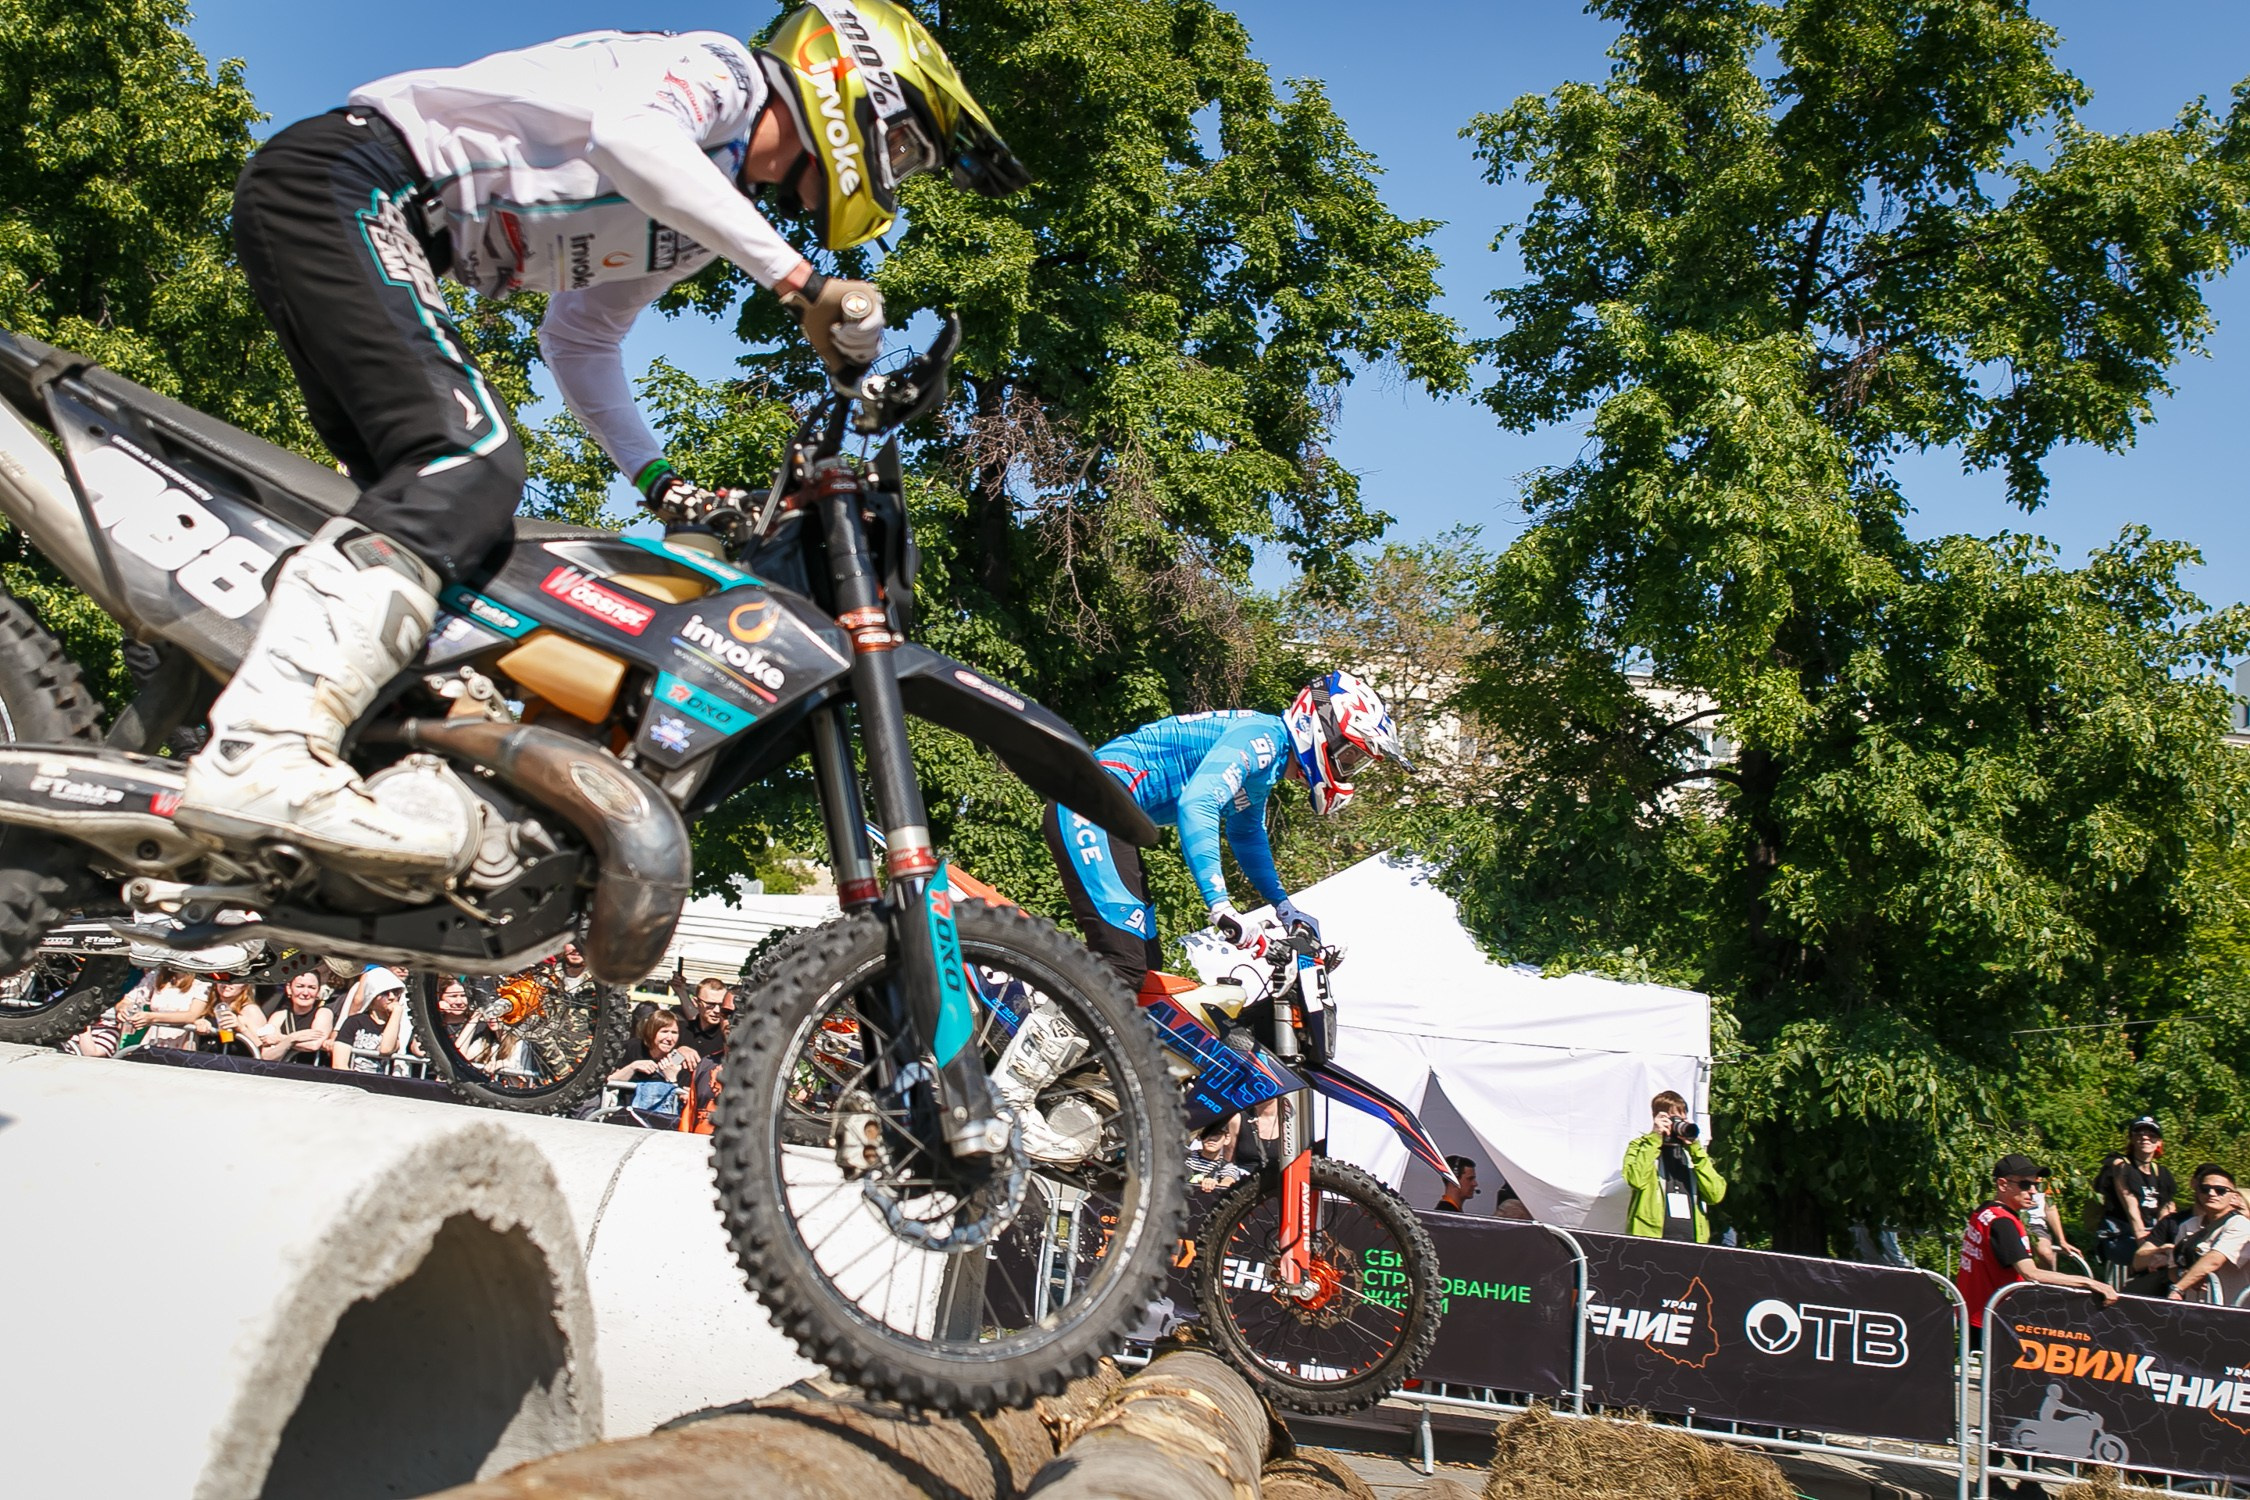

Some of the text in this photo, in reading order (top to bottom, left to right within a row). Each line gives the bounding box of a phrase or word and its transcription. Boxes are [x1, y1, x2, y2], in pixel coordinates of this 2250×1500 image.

[842, 9, 898, 106] 100%
[808, 57, 861, 197] invoke
[681, 614, 785, 690] invoke
[1249, 737, 1272, 770] 96
[1001, 1004, 1020, 1023] 300
[1195, 1093, 1223, 1114] PRO
[1661, 1298, 1698, 1311] УРАЛ
[2015, 1323, 2092, 1342] ФЕСТИВАЛЬ
[2225, 1365, 2250, 1380] УРА
